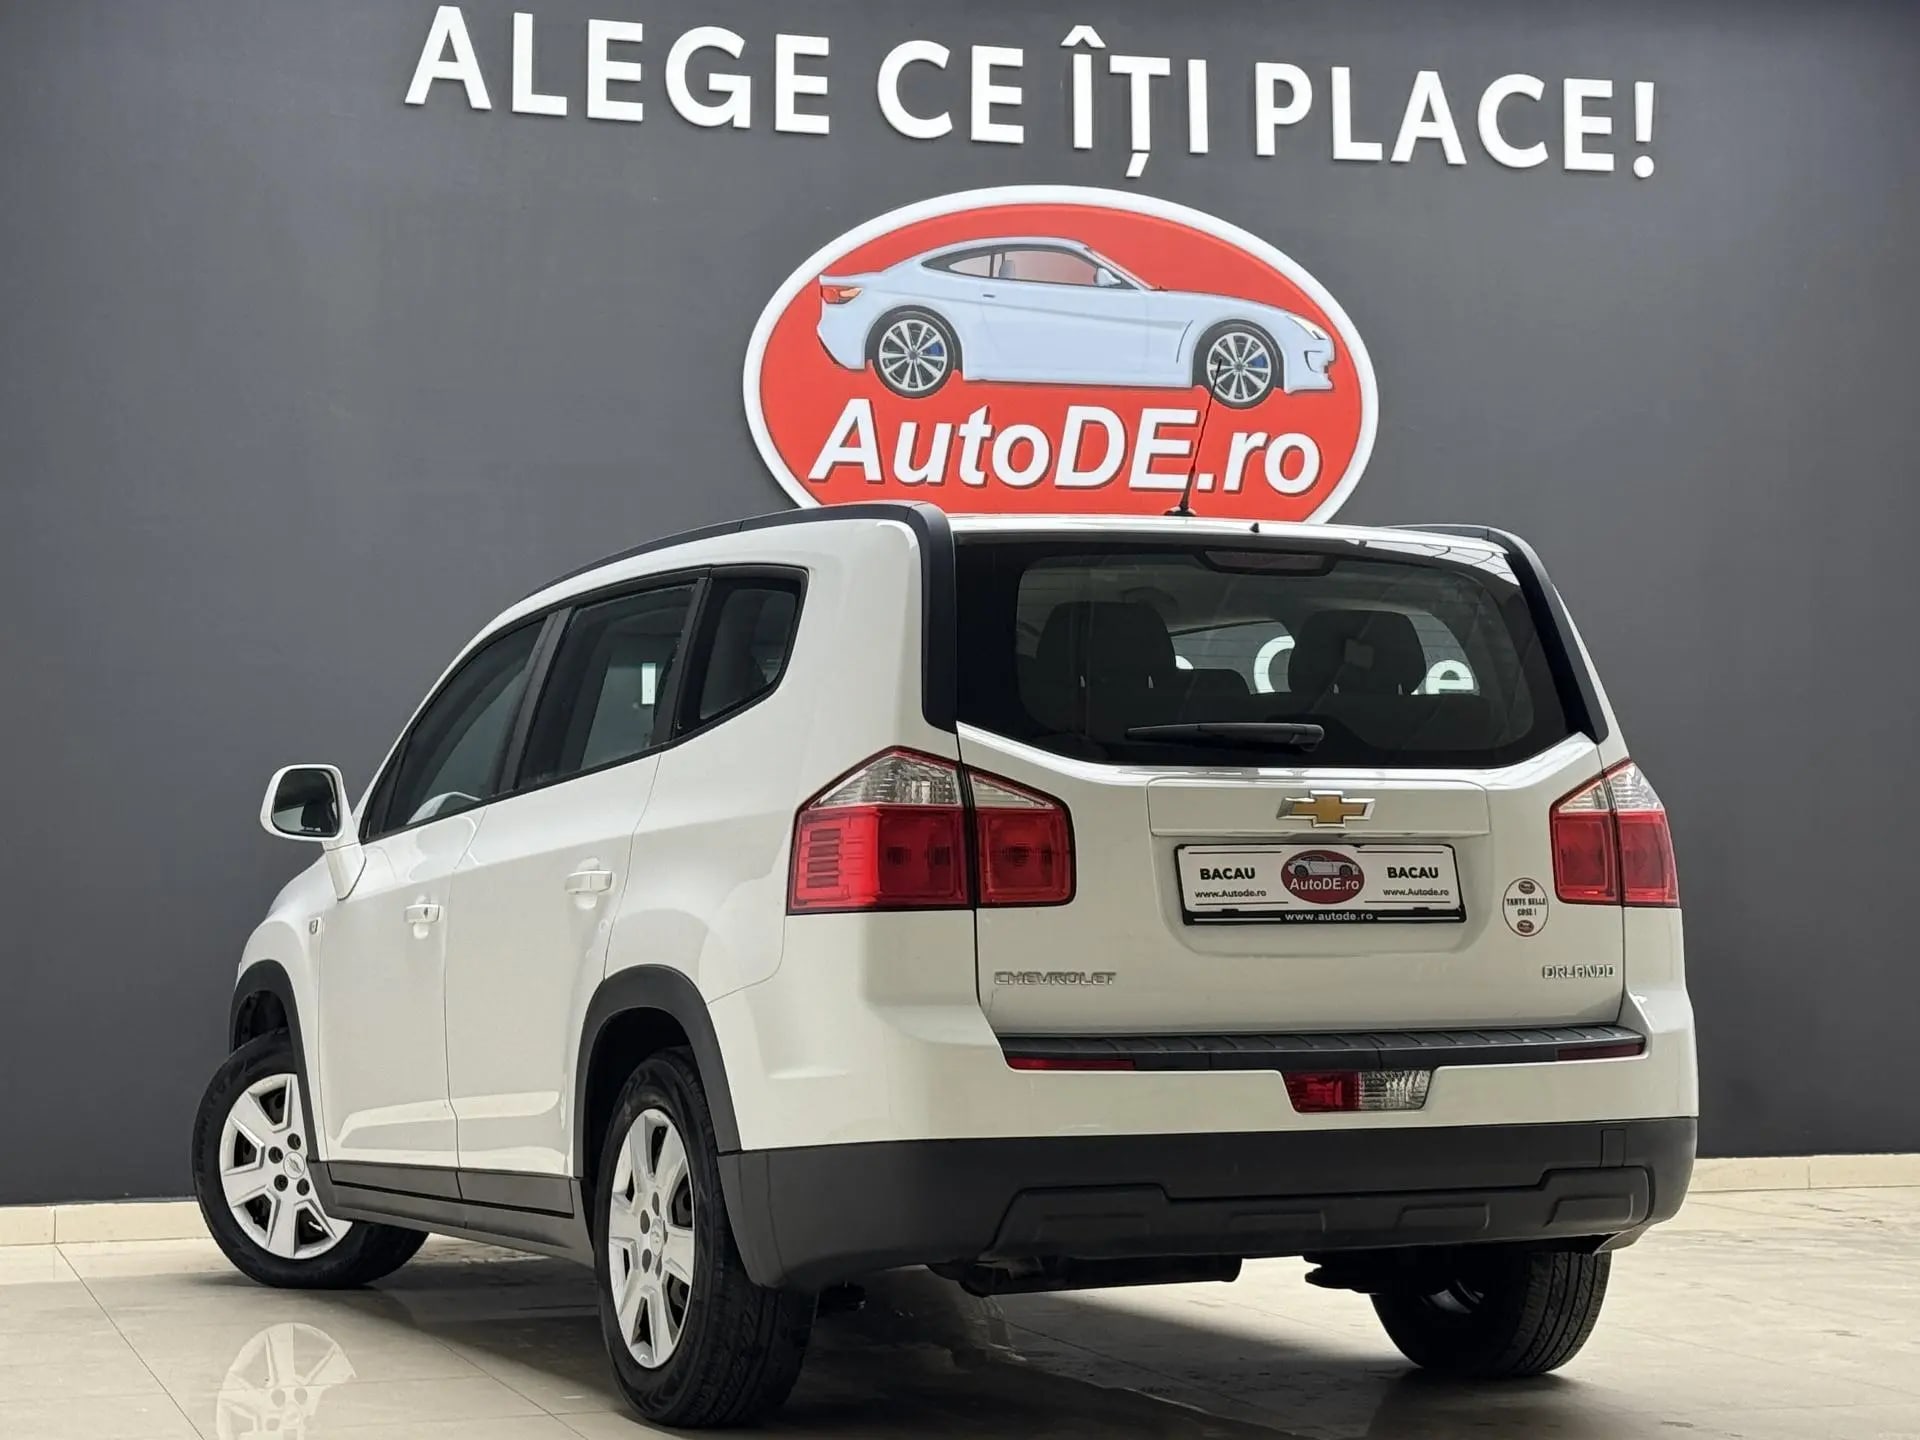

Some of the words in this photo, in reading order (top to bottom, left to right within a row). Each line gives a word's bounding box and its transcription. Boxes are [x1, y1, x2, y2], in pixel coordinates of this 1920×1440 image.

[404, 5, 830, 134] ALEGE
[877, 40, 1024, 144] CE
[1255, 61, 1655, 178] PLACE!
[808, 398, 1323, 495] AutoDE.ro
[1199, 867, 1256, 881] BACAU
[1386, 866, 1439, 880] BACAU
[1289, 876, 1360, 891] AutoDE.ro
[1194, 888, 1267, 898] www.Autode.ro
[1382, 887, 1450, 897] www.Autode.ro
[1284, 912, 1374, 922] www.autode.ro
[994, 971, 1117, 986] CHEVROLET
[1541, 964, 1615, 980] ORLANDO
